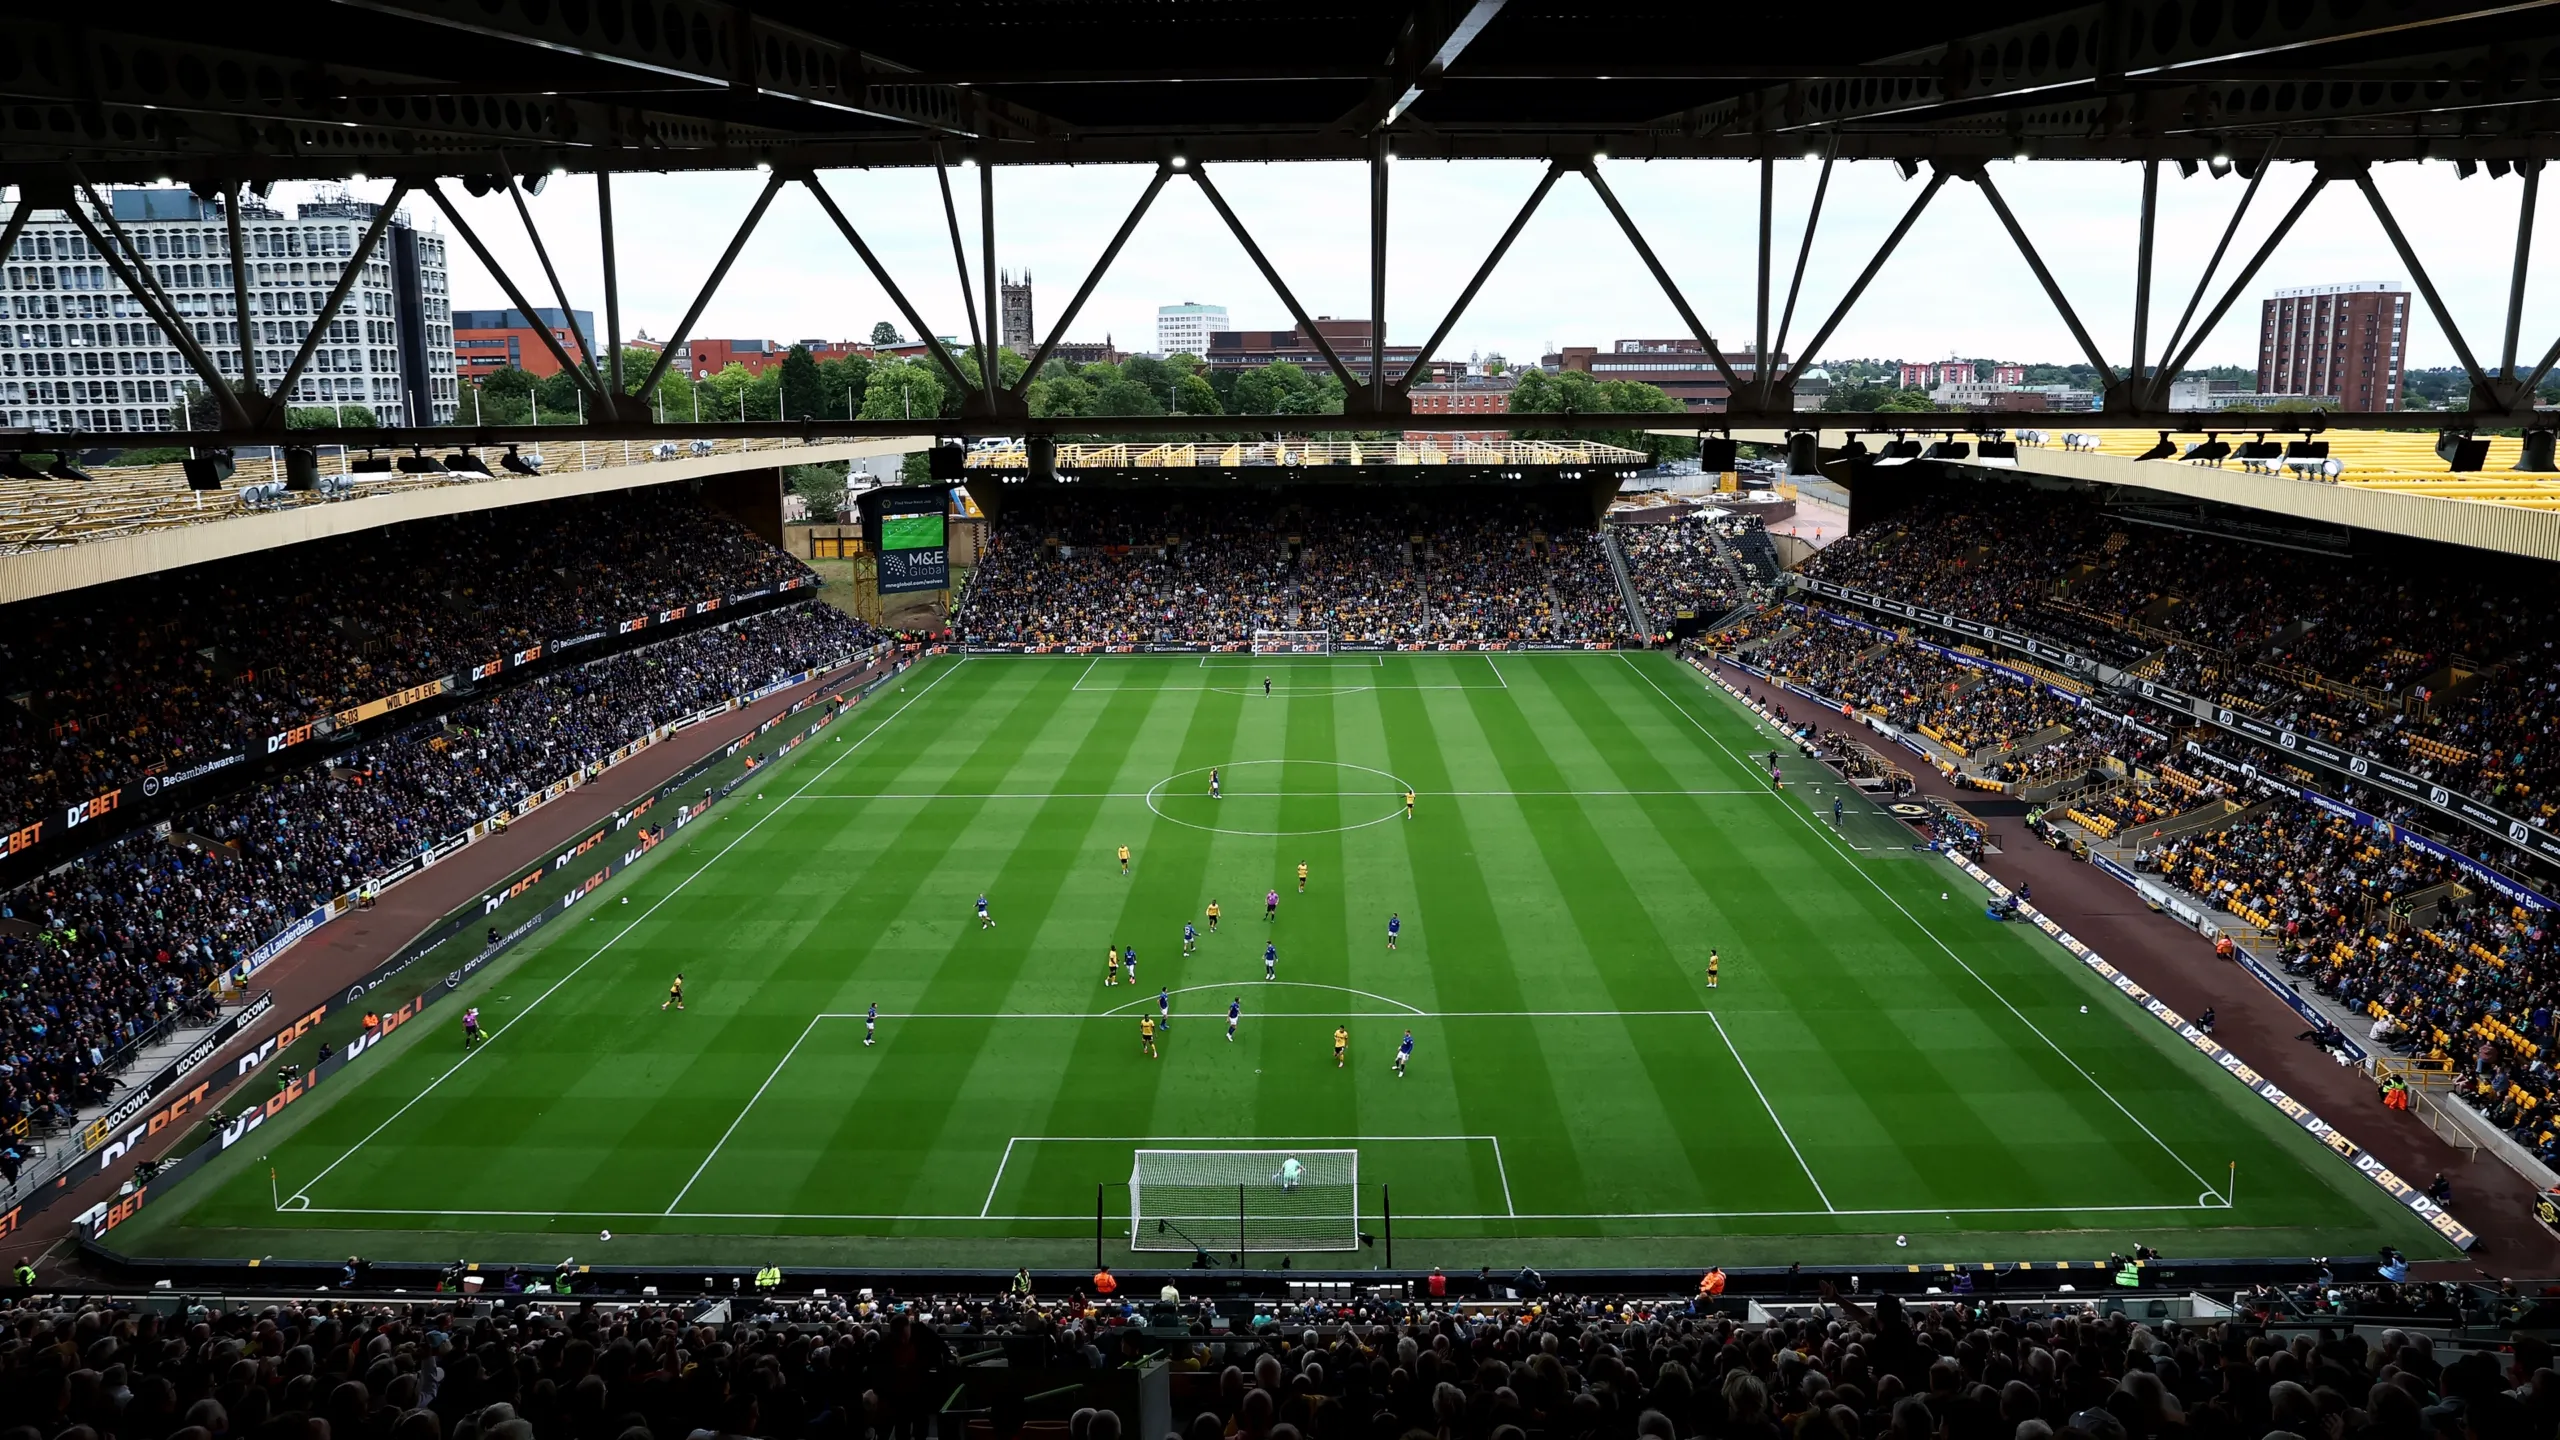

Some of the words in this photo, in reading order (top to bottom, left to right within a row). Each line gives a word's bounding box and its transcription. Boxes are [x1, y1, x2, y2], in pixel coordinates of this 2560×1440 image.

[909, 551, 944, 566] M&E
[909, 565, 945, 577] Global
[660, 606, 686, 624] DEBET
[696, 598, 721, 614] DEBET
[620, 616, 649, 634] DEBET
[514, 645, 542, 666] DEBET
[1397, 643, 1427, 651] DEBET
[1438, 643, 1468, 651] DEBET
[1478, 643, 1508, 651] DEBET
[1583, 642, 1613, 650] DEBET
[472, 659, 502, 681] DEBET
[386, 697, 402, 710] WOL
[404, 688, 419, 703] 0-0
[423, 682, 436, 697] EVE
[268, 724, 313, 753] DEBET
[2305, 745, 2340, 762] JDSPORTS.COM
[163, 754, 245, 787] BeGambleAware.org
[2379, 771, 2419, 791] JDSPORTS.COM
[545, 779, 567, 799] DEBET
[68, 789, 121, 829] DEBET
[518, 793, 543, 814] DEBET
[2461, 804, 2498, 826] JDSPORTS.COM
[0, 821, 43, 860] EBET
[1965, 863, 1990, 884] DEBET
[2404, 835, 2426, 853] Book
[2457, 860, 2474, 872] visit
[2475, 869, 2489, 885] the
[2490, 877, 2514, 898] home
[2515, 891, 2526, 904] of
[2033, 912, 2063, 936] DEBET
[251, 946, 270, 967] Visit
[270, 918, 314, 955] Lauderdale
[2058, 932, 2089, 957] DEBET
[2086, 953, 2119, 980] DEBET
[2147, 999, 2186, 1029] DEBET
[2181, 1023, 2223, 1057] DEBET
[2218, 1052, 2265, 1087] DEBET
[2260, 1083, 2310, 1121] DEBET
[2305, 1116, 2359, 1159] DEBET
[2355, 1153, 2414, 1199] DEBET
[94, 1186, 148, 1239] EBET
[2410, 1195, 2474, 1244] DEBET
[1071, 1302, 1080, 1311] 12
